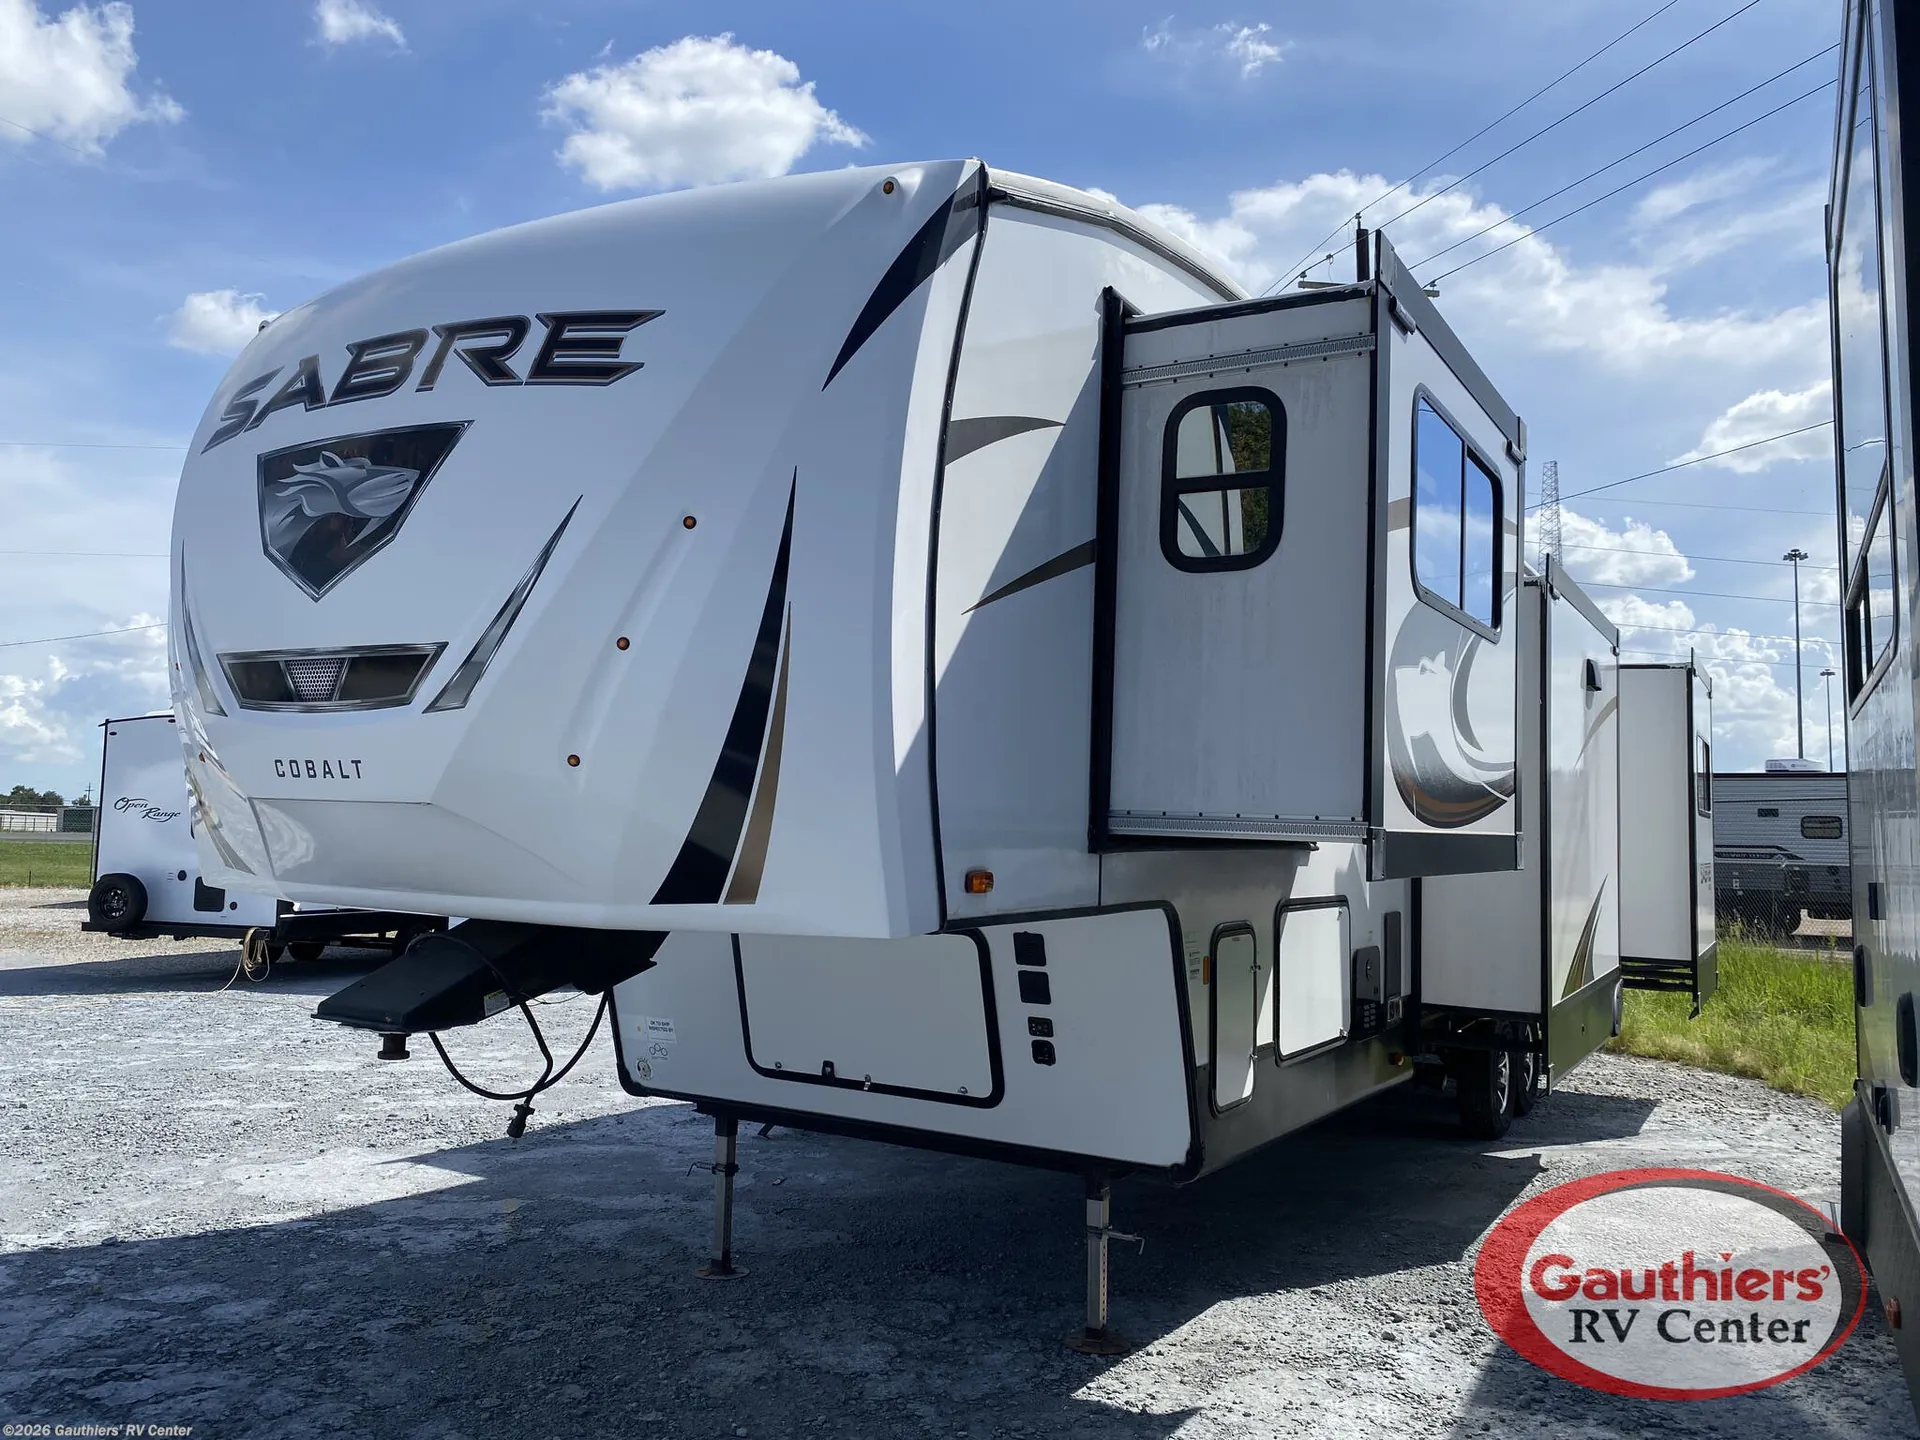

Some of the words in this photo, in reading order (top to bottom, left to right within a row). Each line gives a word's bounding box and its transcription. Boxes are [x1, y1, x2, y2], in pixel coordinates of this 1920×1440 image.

[200, 309, 666, 454] SABRE
[274, 759, 362, 779] COBALT
[114, 797, 149, 813] Open
[140, 807, 181, 823] Range
